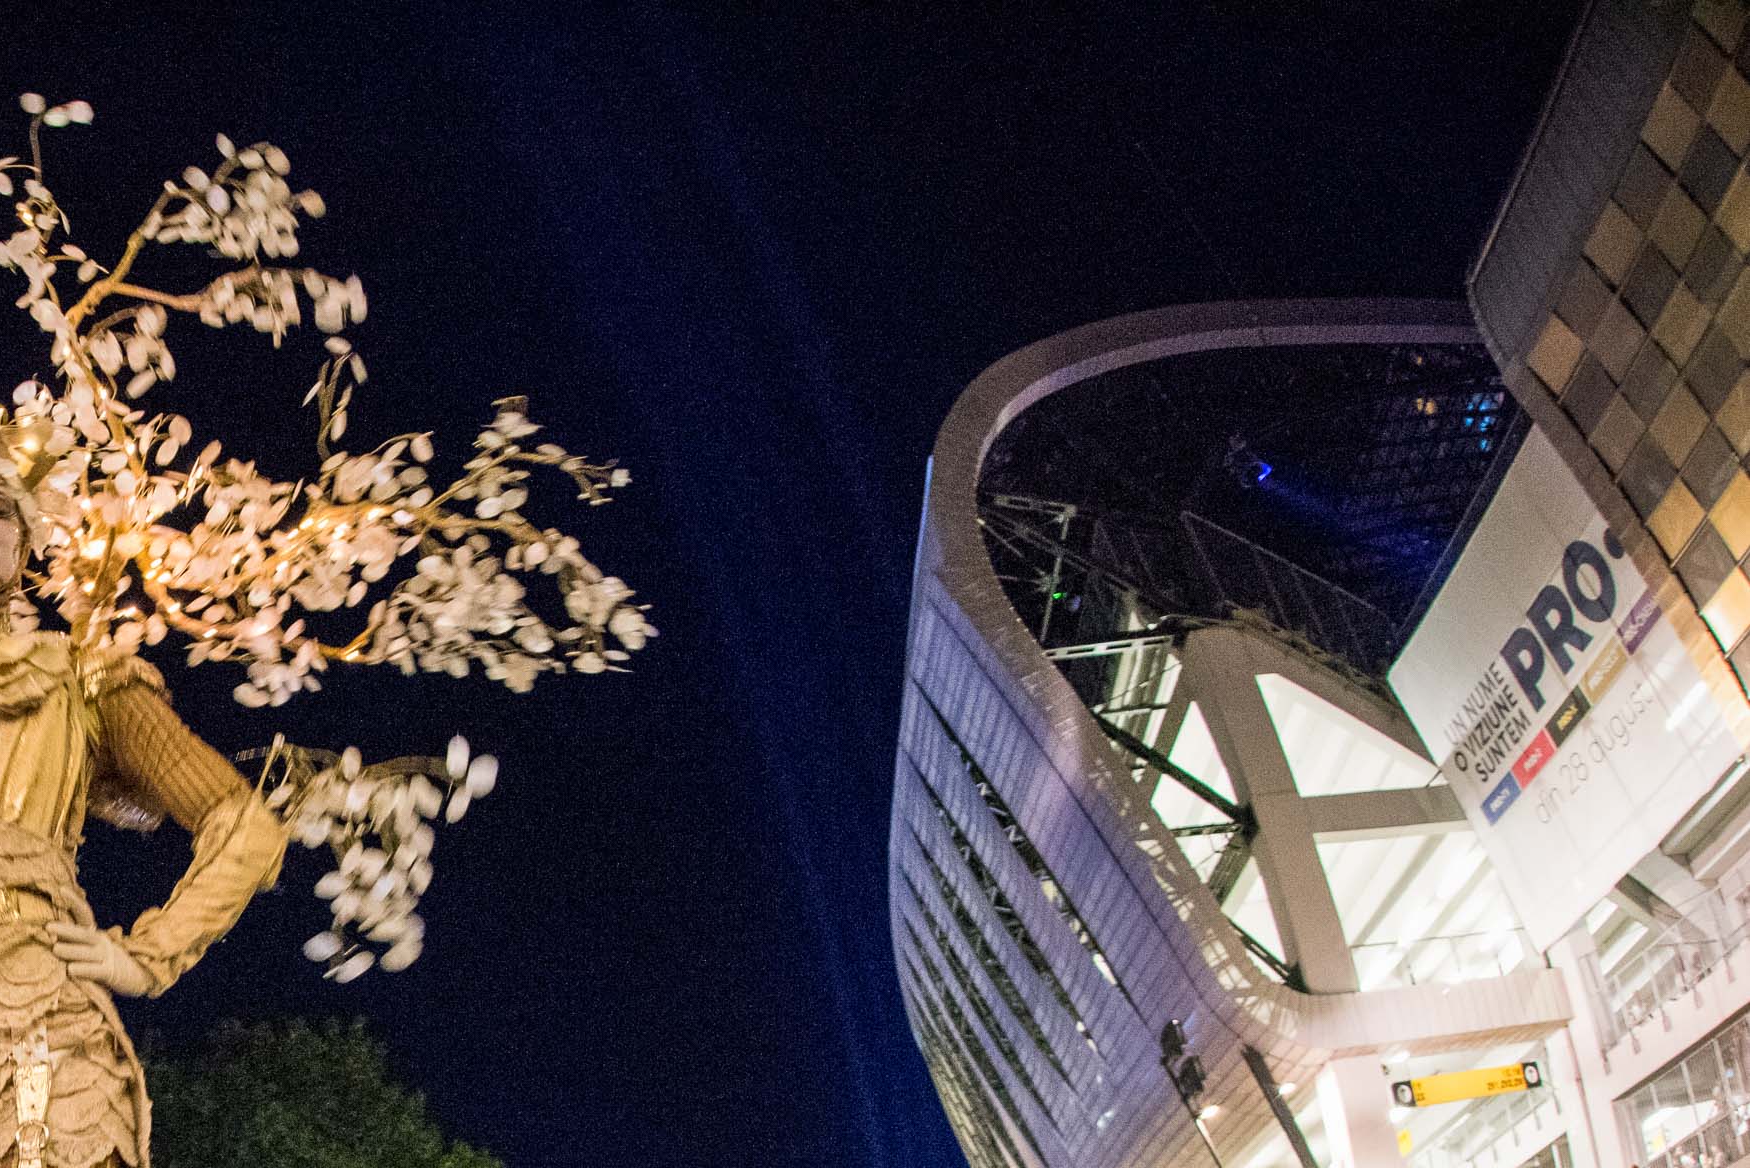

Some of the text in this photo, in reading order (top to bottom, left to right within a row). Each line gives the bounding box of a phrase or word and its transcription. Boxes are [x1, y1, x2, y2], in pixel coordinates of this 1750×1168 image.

[1443, 661, 1504, 746] UN NUME
[1454, 751, 1468, 772] O
[1463, 684, 1518, 757] VIZIUNE
[1475, 708, 1532, 782] SUNTEM
[1560, 752, 1588, 795] 28
[1588, 683, 1653, 763] august
